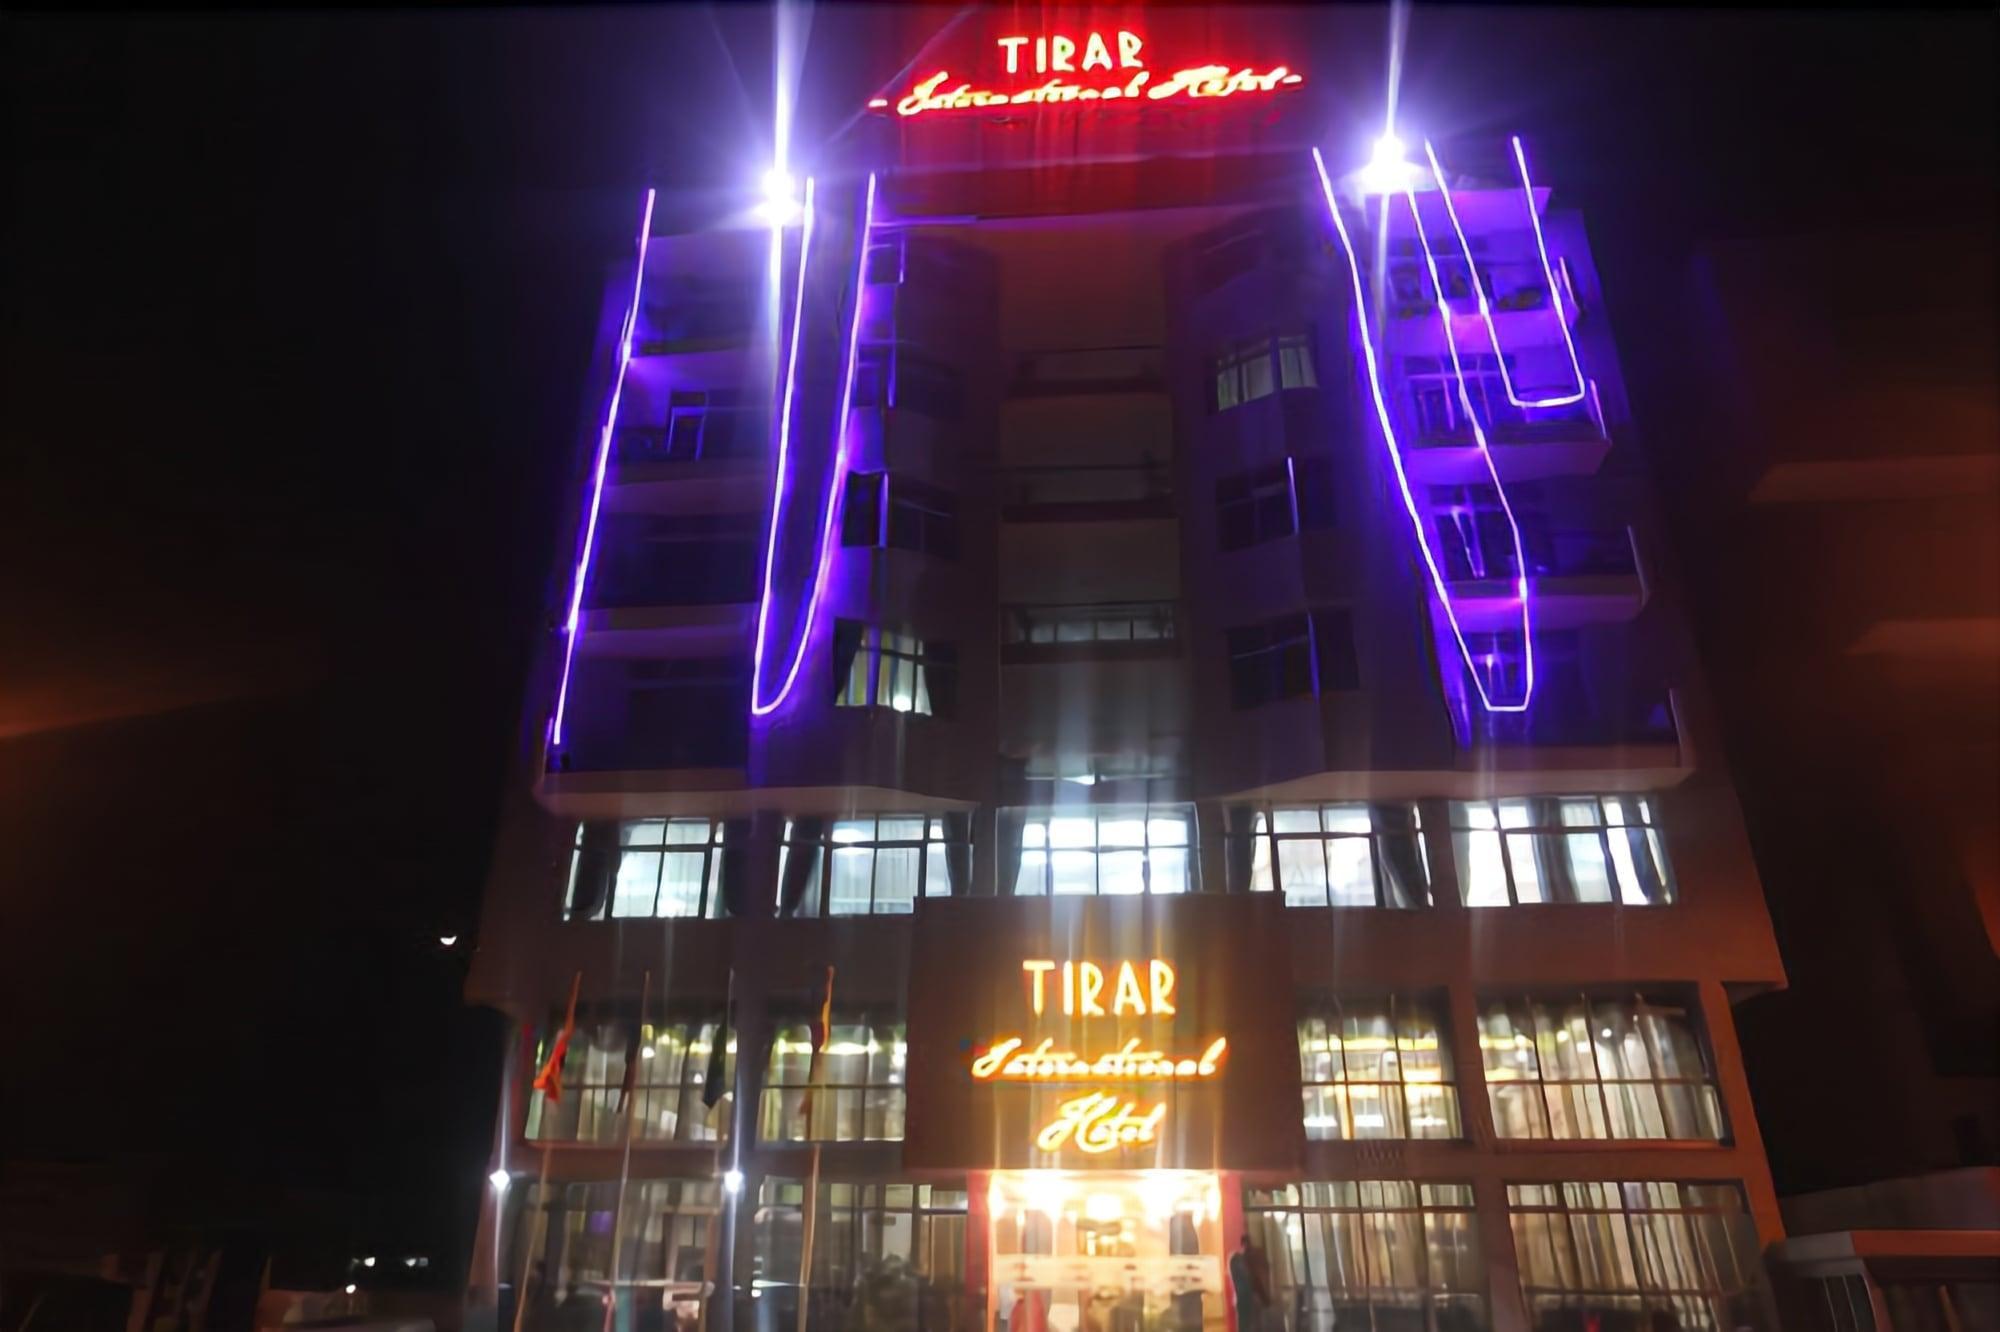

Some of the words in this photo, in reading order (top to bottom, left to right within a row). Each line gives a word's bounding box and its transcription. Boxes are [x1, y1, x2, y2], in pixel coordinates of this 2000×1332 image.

[997, 31, 1144, 74] TIRAR
[897, 70, 1150, 115] International
[1148, 65, 1288, 100] Hotel
[1022, 959, 1177, 1016] TIRAR
[971, 1036, 1228, 1078] International
[1036, 1091, 1167, 1153] Hotel
